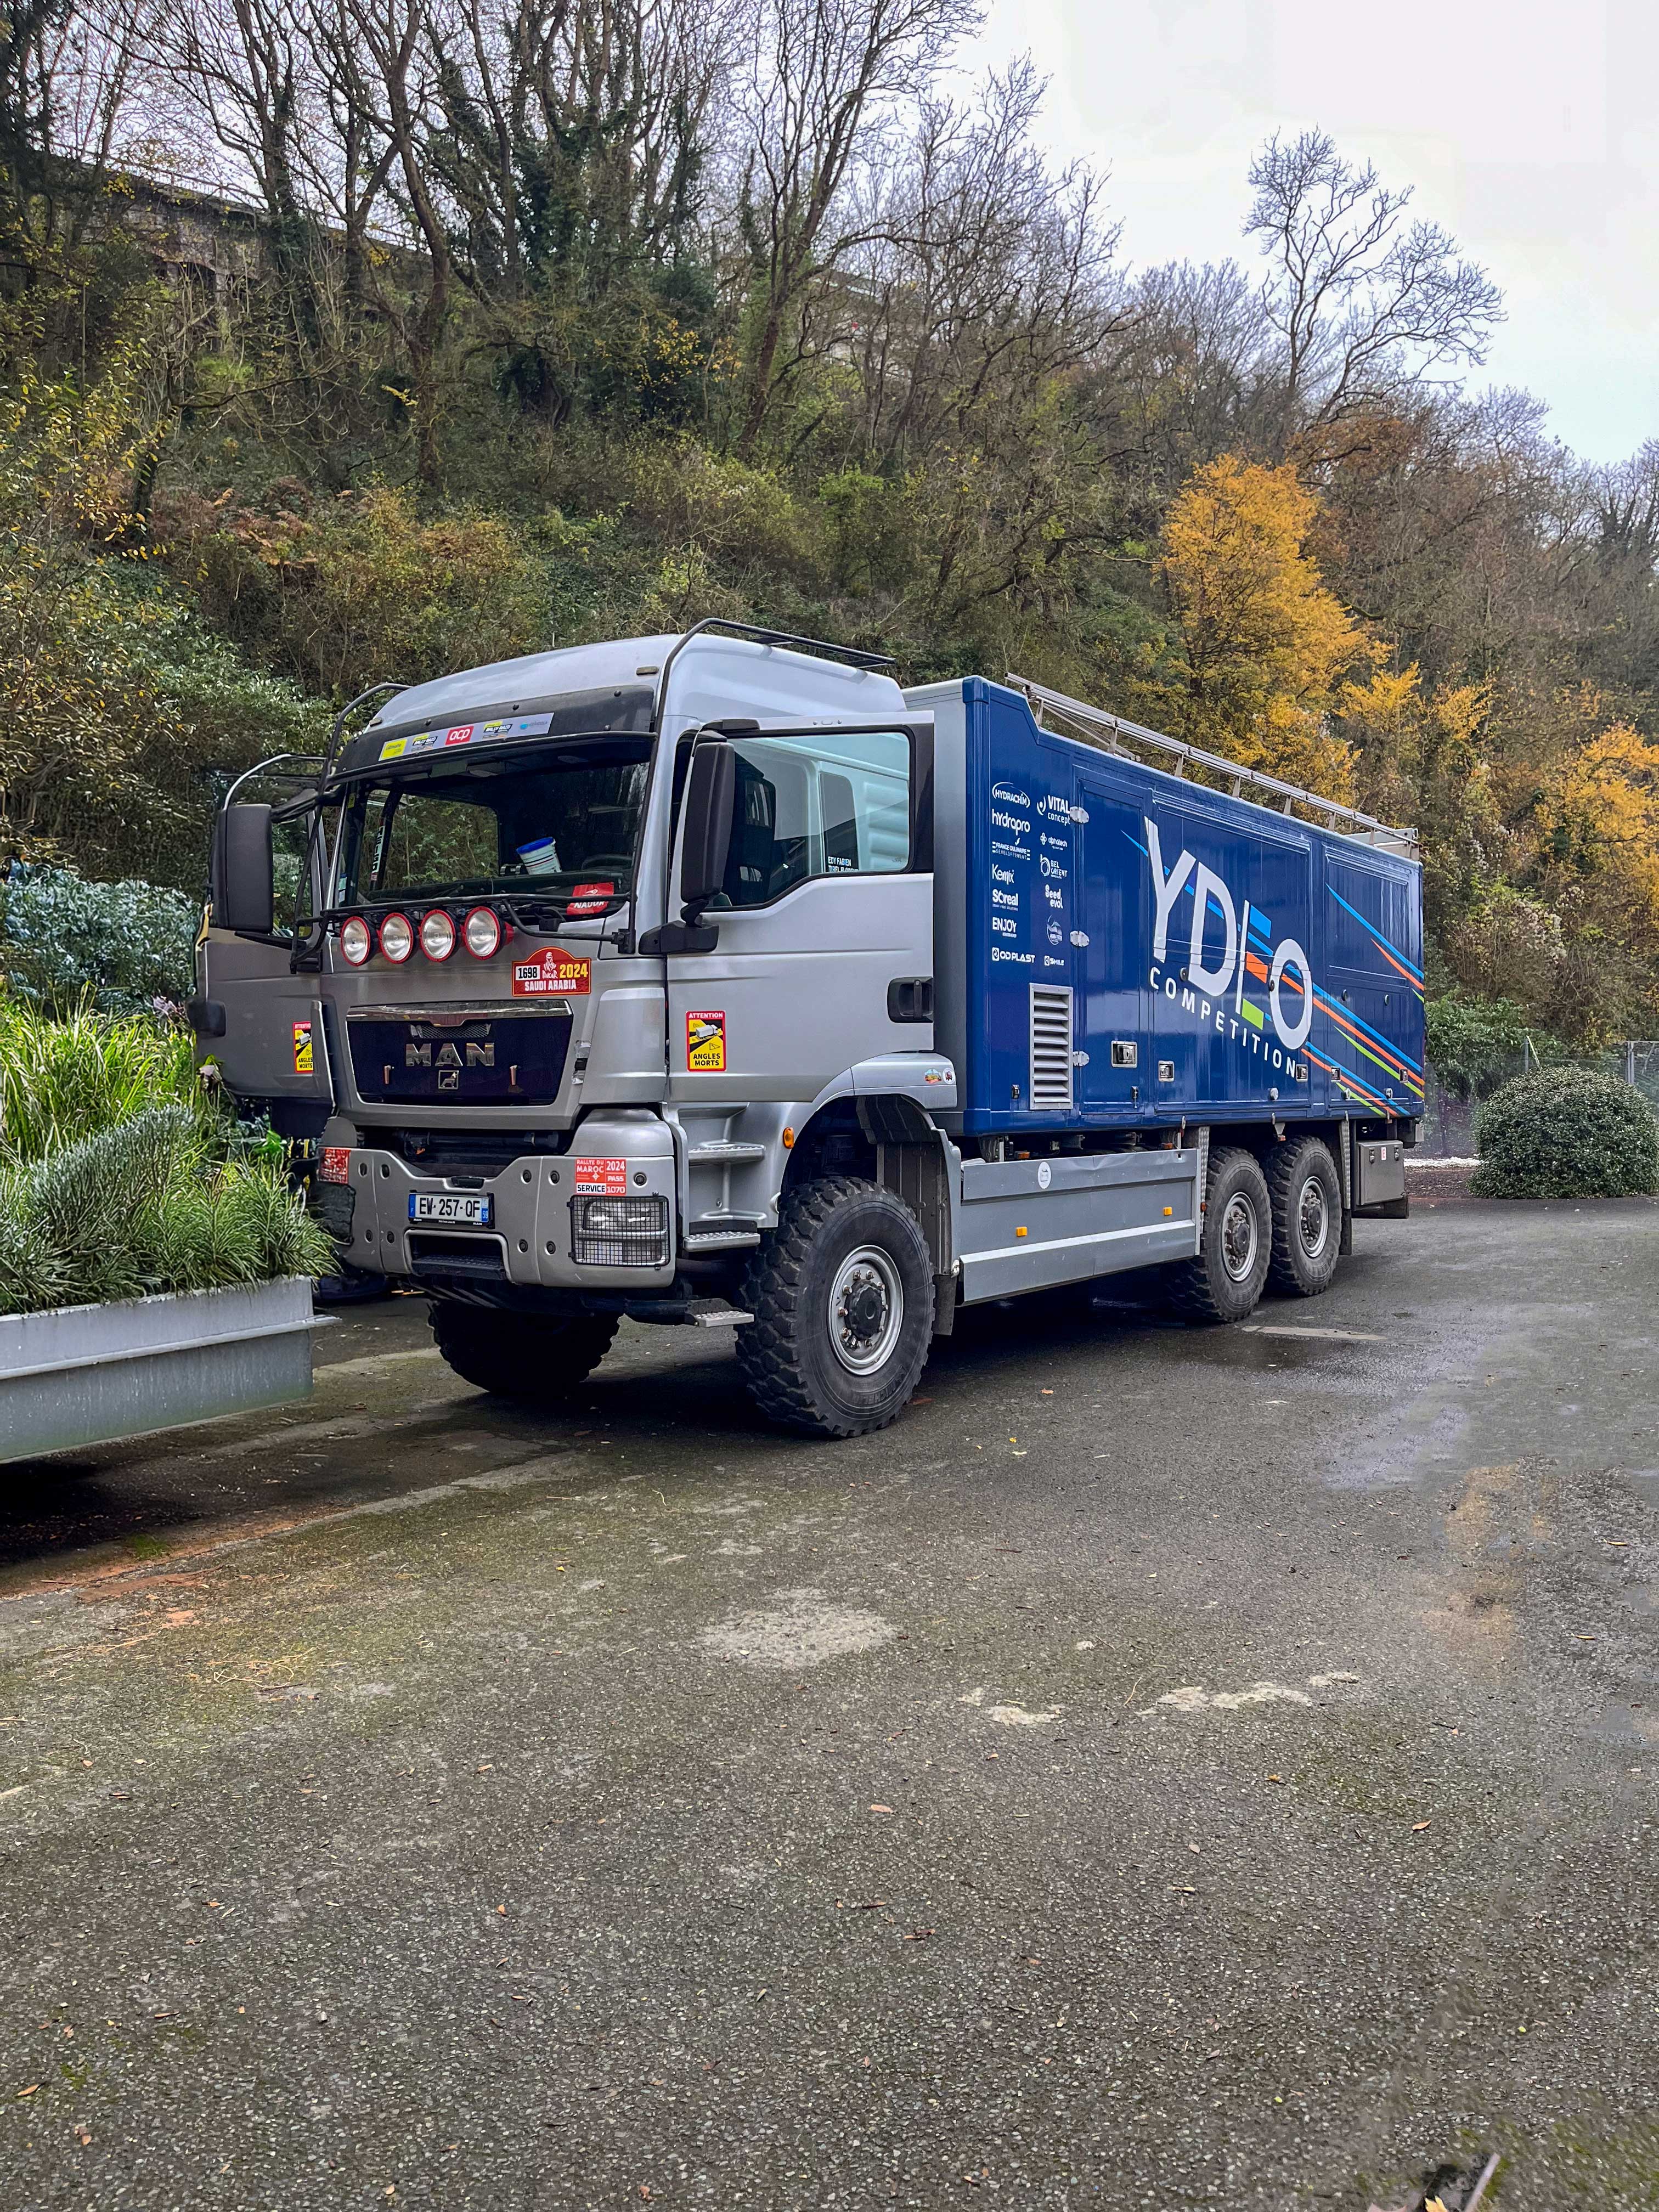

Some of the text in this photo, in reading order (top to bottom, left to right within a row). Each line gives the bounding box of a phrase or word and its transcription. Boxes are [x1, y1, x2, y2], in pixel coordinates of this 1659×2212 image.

[449, 728, 471, 741] acp
[1048, 794, 1070, 814] VITAL
[1048, 812, 1070, 826] concept
[996, 842, 1009, 850] FRANCE
[1045, 884, 1061, 900] Seed
[1050, 898, 1063, 909] evol
[992, 917, 1017, 933] ENJOY
[518, 967, 537, 979] 1698
[560, 963, 589, 978] 2024
[524, 979, 577, 991] SAUDI ARABIA
[1150, 967, 1296, 1078] COMPETITION
[406, 1042, 494, 1066] MAN
[606, 1161, 625, 1171] 2024
